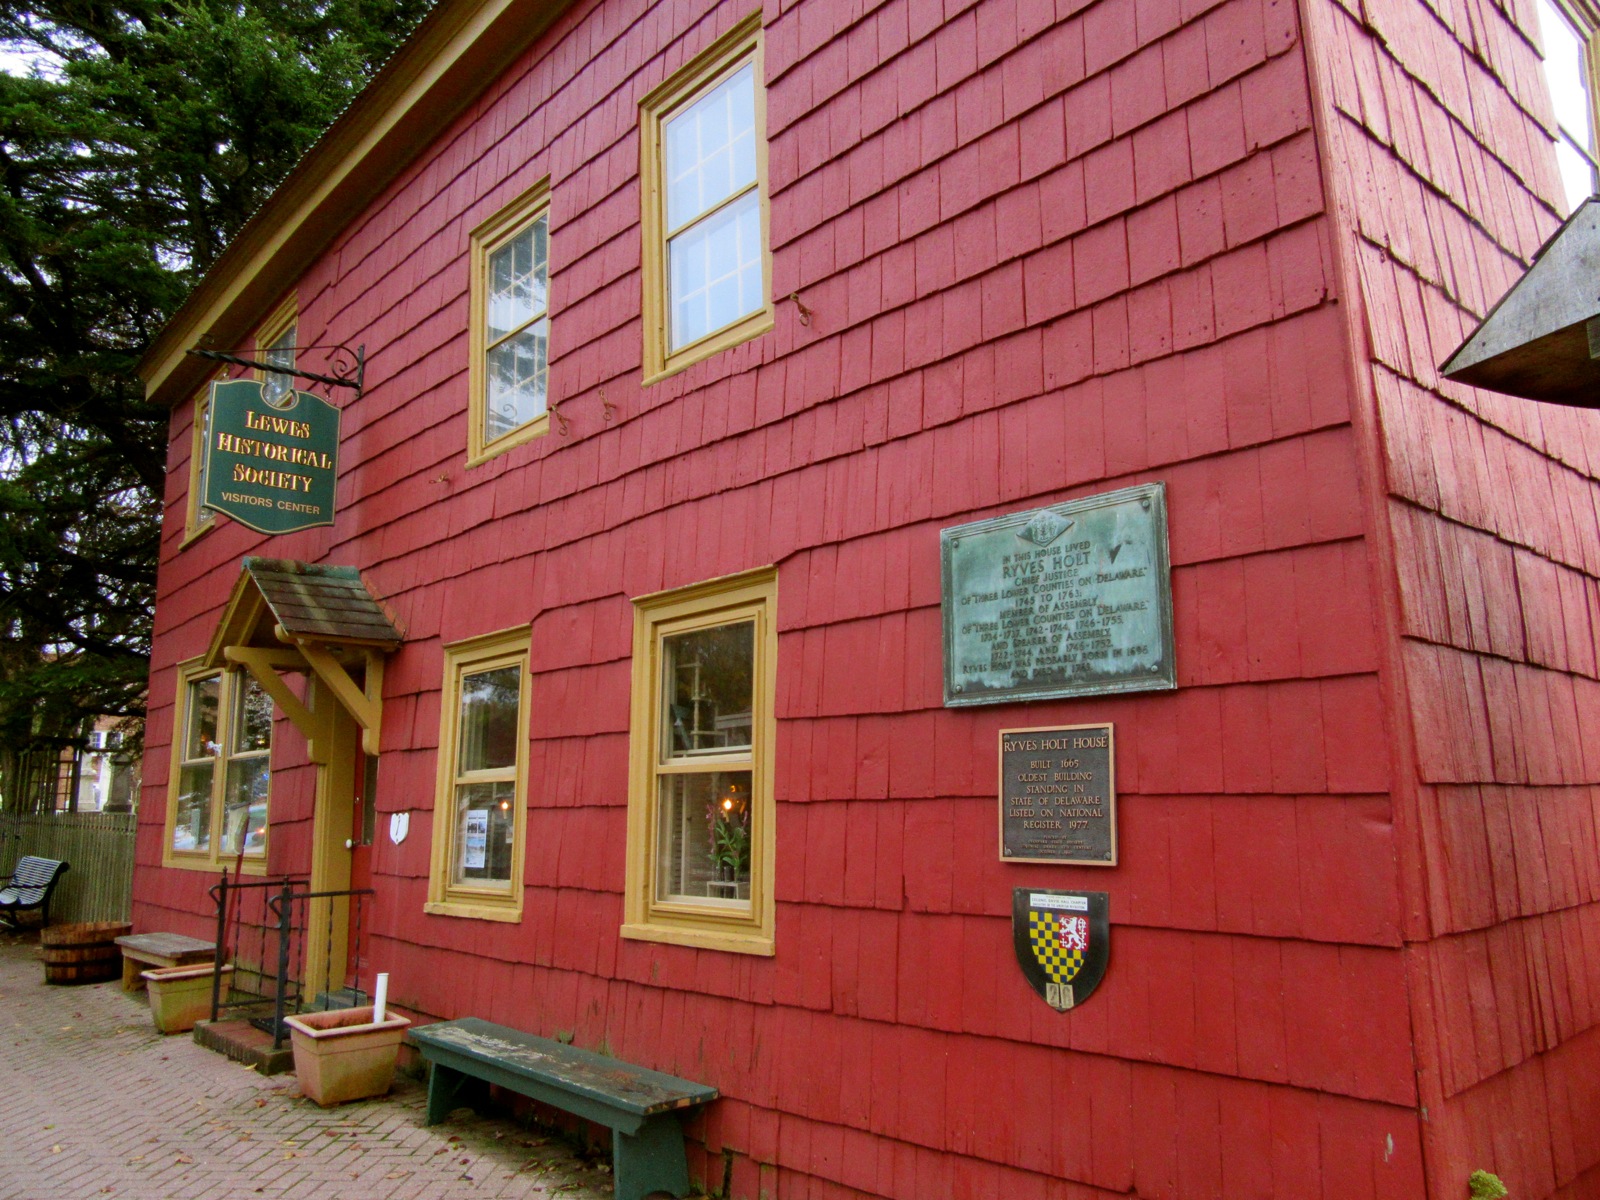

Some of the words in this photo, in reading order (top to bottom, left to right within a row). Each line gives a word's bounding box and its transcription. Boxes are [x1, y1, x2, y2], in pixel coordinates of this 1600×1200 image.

[245, 410, 310, 439] LEWES
[217, 432, 332, 470] HISTORICAL
[233, 463, 313, 493] SOCIETY
[221, 491, 273, 507] VISITORS
[277, 500, 320, 515] CENTER
[1003, 555, 1011, 565] IN
[1014, 552, 1031, 562] THIS
[1035, 546, 1061, 559] HOUSE
[1065, 541, 1090, 553] LIVED
[1003, 560, 1044, 579] RYVES
[1052, 551, 1091, 570] HOLT
[1014, 575, 1040, 587] CHIEF
[1043, 568, 1079, 582] JUSTICE
[961, 596, 971, 605] OF
[1001, 588, 1029, 599] LOWER
[1032, 579, 1074, 594] COUNTIES
[1078, 576, 1092, 586] ON
[1041, 594, 1053, 603] TO
[1038, 604, 1049, 614] OF
[1053, 595, 1098, 611] ASSEMBLY
[1033, 611, 1075, 625] COUNTIES
[1079, 609, 1093, 618] ON
[1051, 634, 1063, 643] OF
[1039, 646, 1058, 655] AND
[1004, 740, 1038, 752] RYVES
[1041, 738, 1068, 750] HOLT
[1073, 735, 1108, 749] HOUSE
[1030, 760, 1052, 769] BUILT
[1061, 759, 1079, 769] 1665
[1017, 773, 1048, 783] OLDEST
[1054, 771, 1093, 782] BUILDING
[1026, 785, 1068, 794] STANDING
[1074, 784, 1084, 793] IN
[1010, 797, 1032, 806] STATE
[1039, 797, 1049, 806] OF
[1054, 796, 1101, 806] DELAWARE
[1009, 808, 1035, 818] LISTED
[1040, 808, 1054, 817] ON
[1059, 808, 1103, 818] NATIONAL
[1023, 820, 1062, 829] REGISTER
